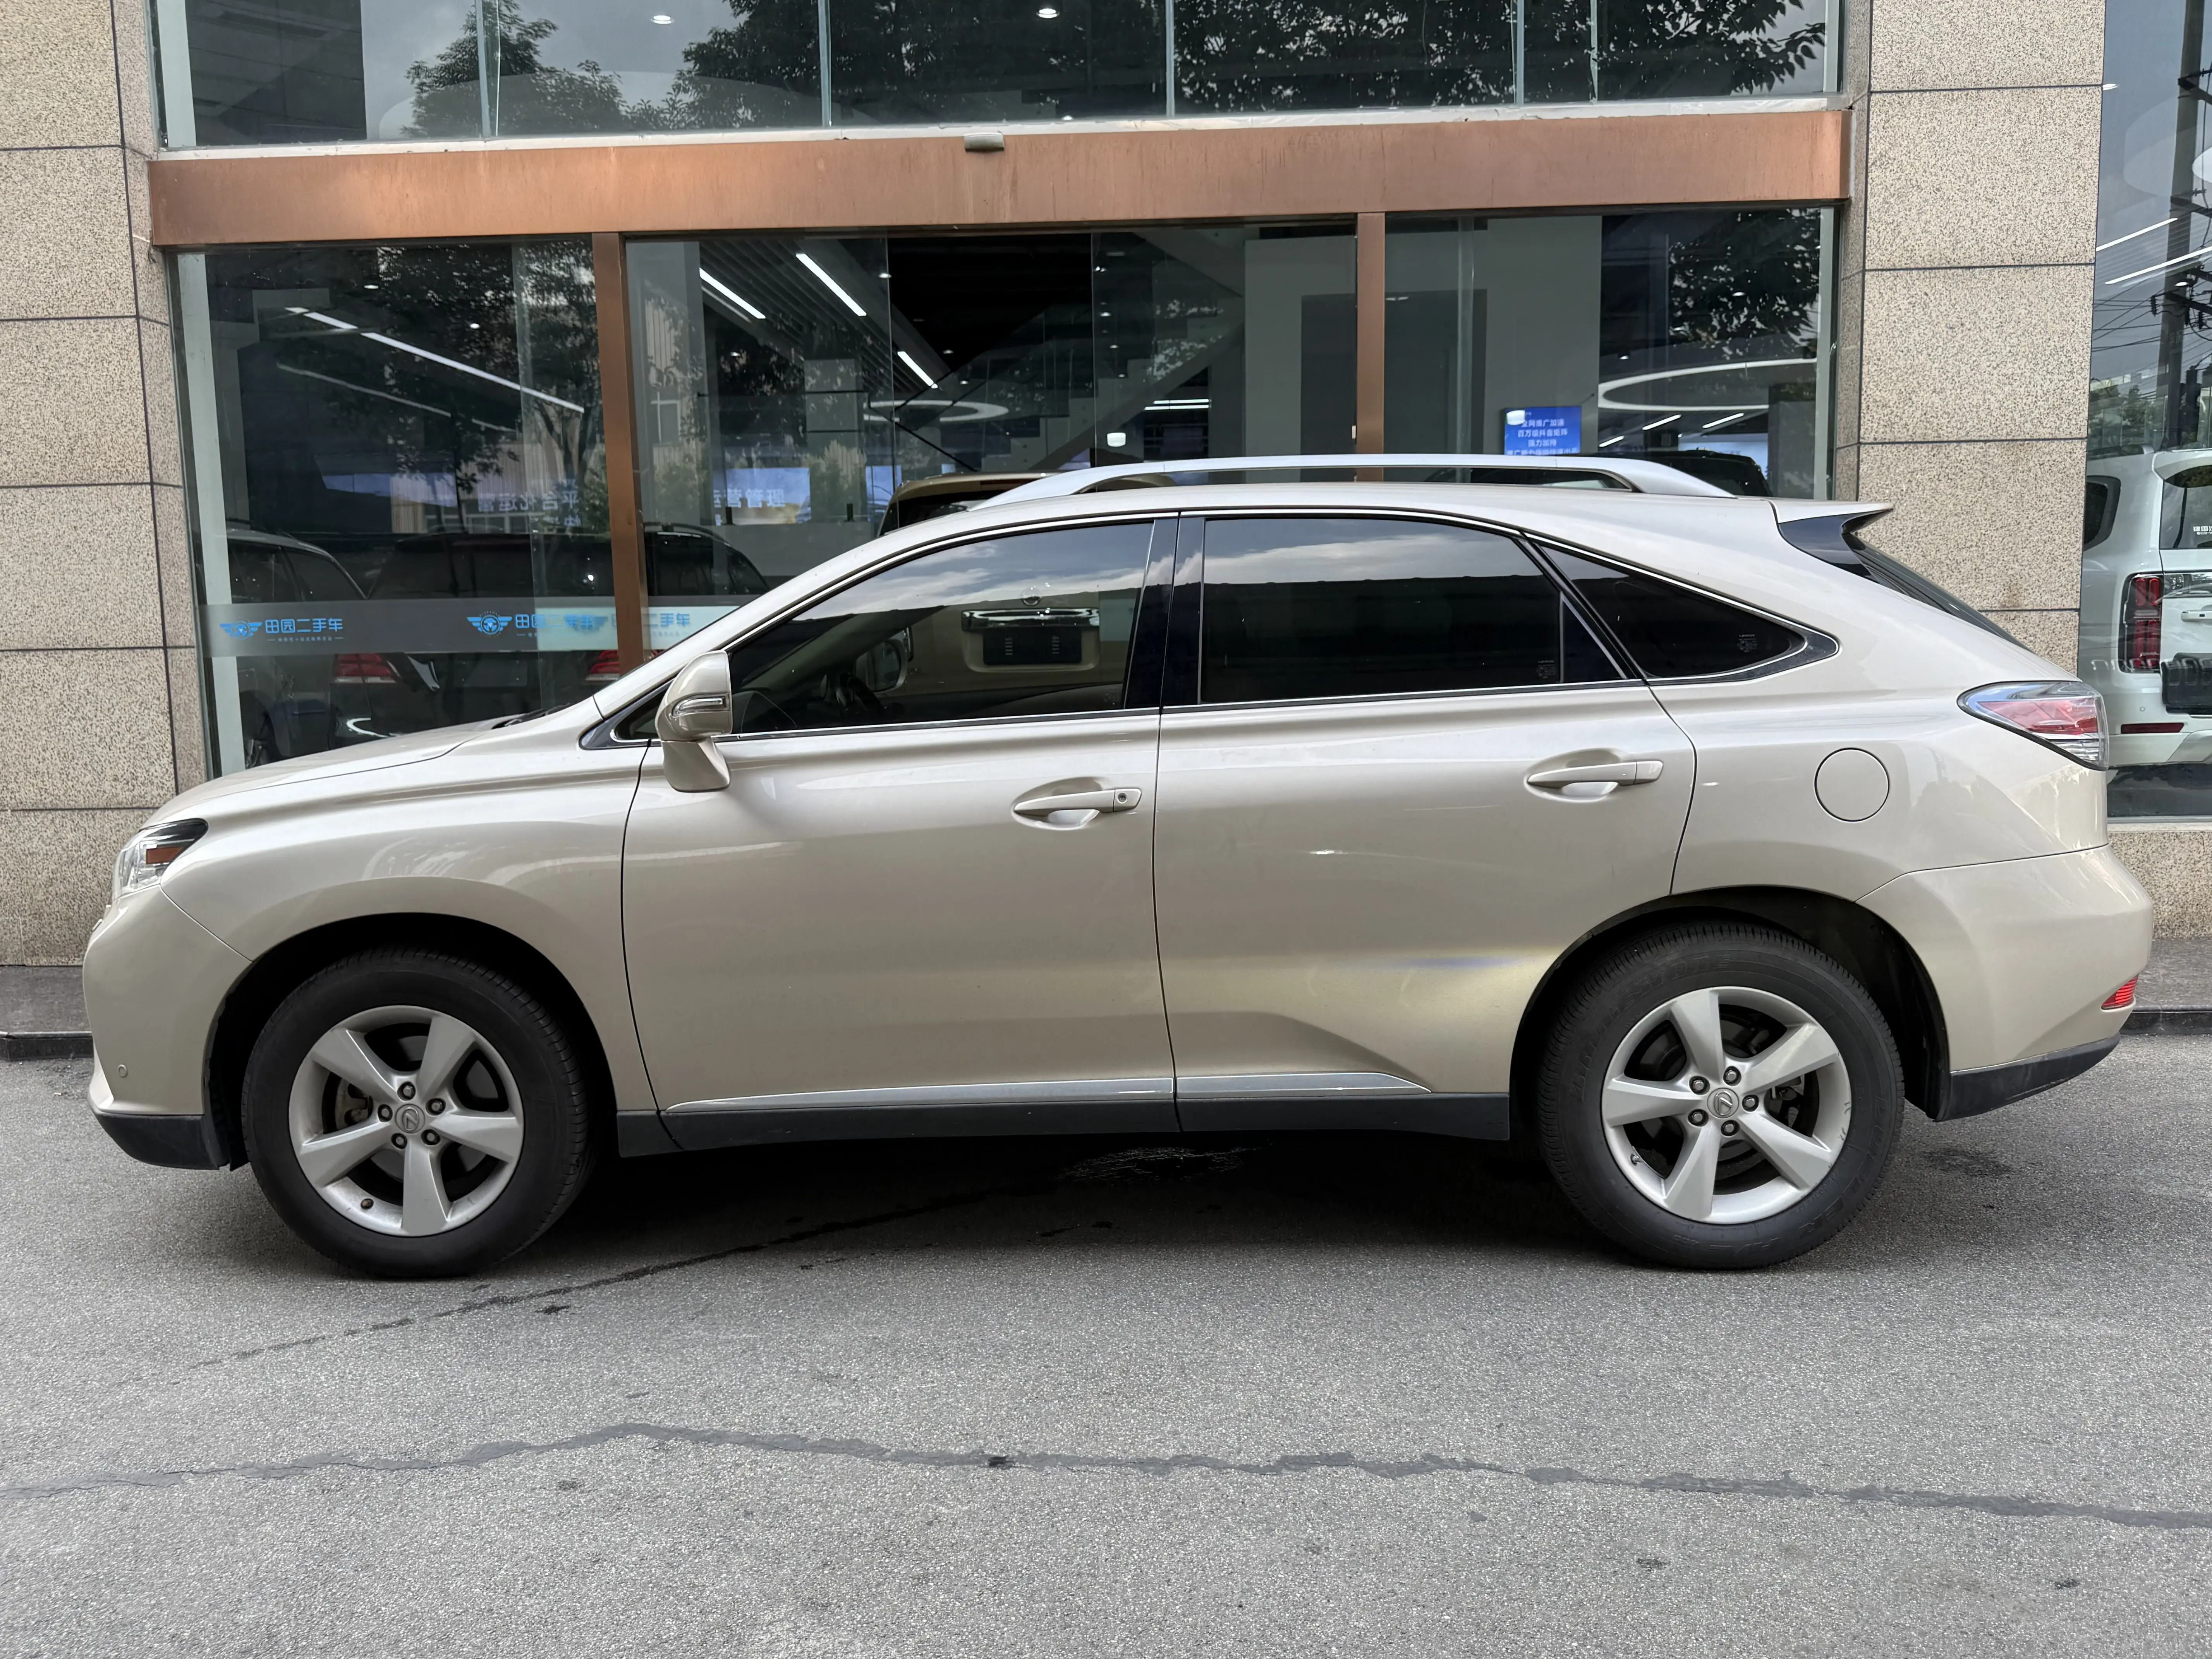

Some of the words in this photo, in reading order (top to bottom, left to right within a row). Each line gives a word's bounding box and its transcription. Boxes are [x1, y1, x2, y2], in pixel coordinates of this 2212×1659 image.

[266, 618, 343, 633] 田园二手车
